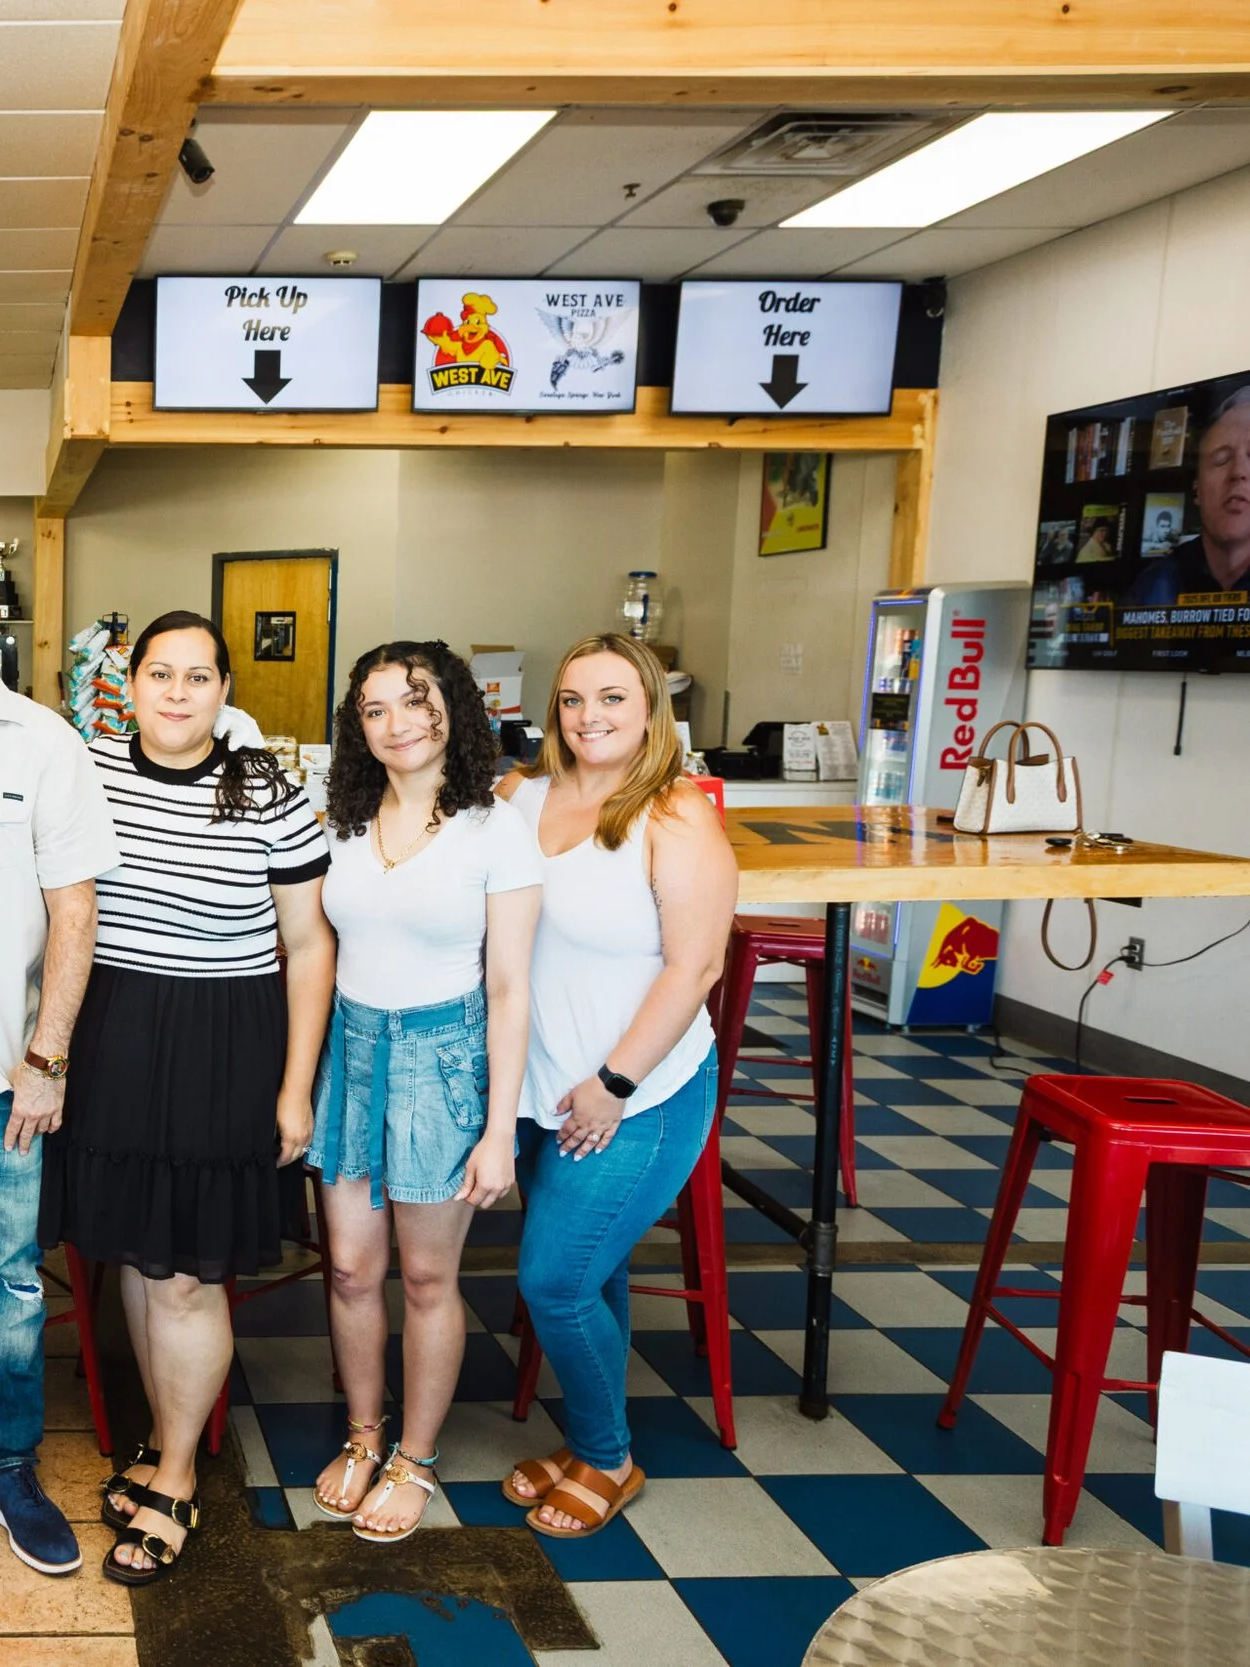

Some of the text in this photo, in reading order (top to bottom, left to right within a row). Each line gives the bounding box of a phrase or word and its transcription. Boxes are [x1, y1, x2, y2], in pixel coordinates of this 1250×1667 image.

[224, 285, 309, 315] Pick Up
[545, 293, 625, 308] WEST AVE
[758, 289, 821, 314] Order
[571, 308, 597, 318] PIZZA
[242, 319, 292, 342] Here
[762, 323, 812, 347] Here
[432, 367, 511, 389] WEST AVE
[1170, 608, 1211, 624] BURROW
[1213, 608, 1235, 623] TIED
[1151, 626, 1196, 640] TAKEAWAY
[1196, 625, 1225, 639] FROM
[939, 618, 987, 771] Red Bull
